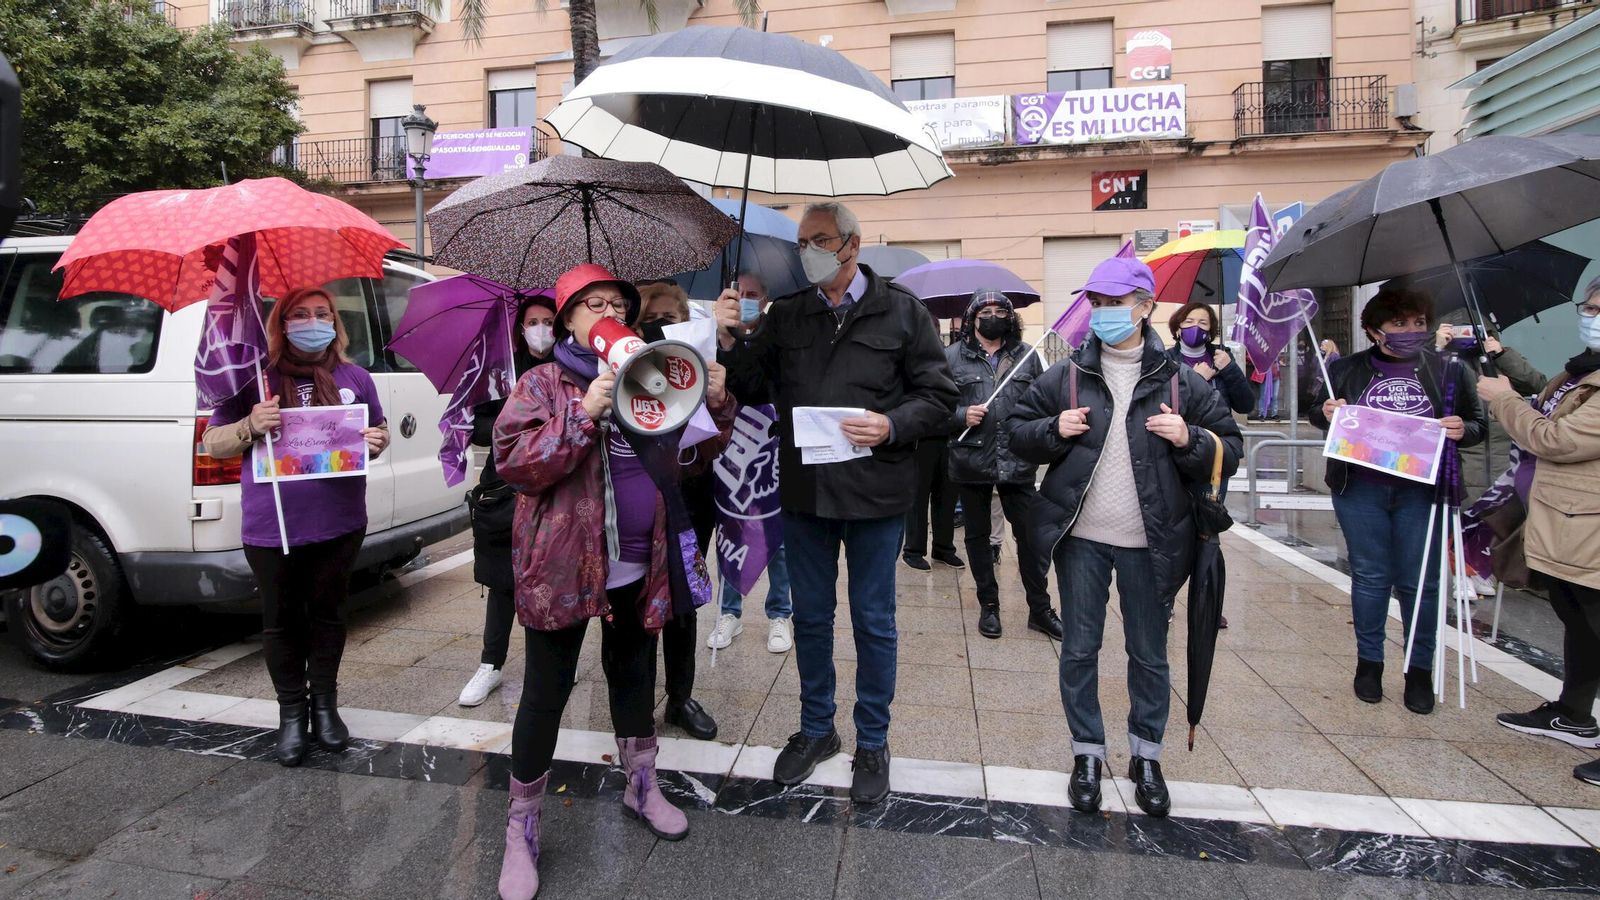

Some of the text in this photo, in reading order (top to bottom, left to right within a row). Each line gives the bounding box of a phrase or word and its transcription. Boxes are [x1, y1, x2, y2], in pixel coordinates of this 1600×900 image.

[1130, 65, 1170, 80] CGT
[908, 100, 1000, 113] osotras paramos
[1020, 95, 1047, 106] CGT
[1065, 91, 1182, 115] TU LUCHA
[943, 119, 973, 133] para
[1052, 115, 1182, 137] ES MI LUCHA
[941, 129, 999, 146] el mundo
[1099, 176, 1140, 193] CNT
[1109, 196, 1131, 205] AIT
[633, 398, 660, 415] UGT
